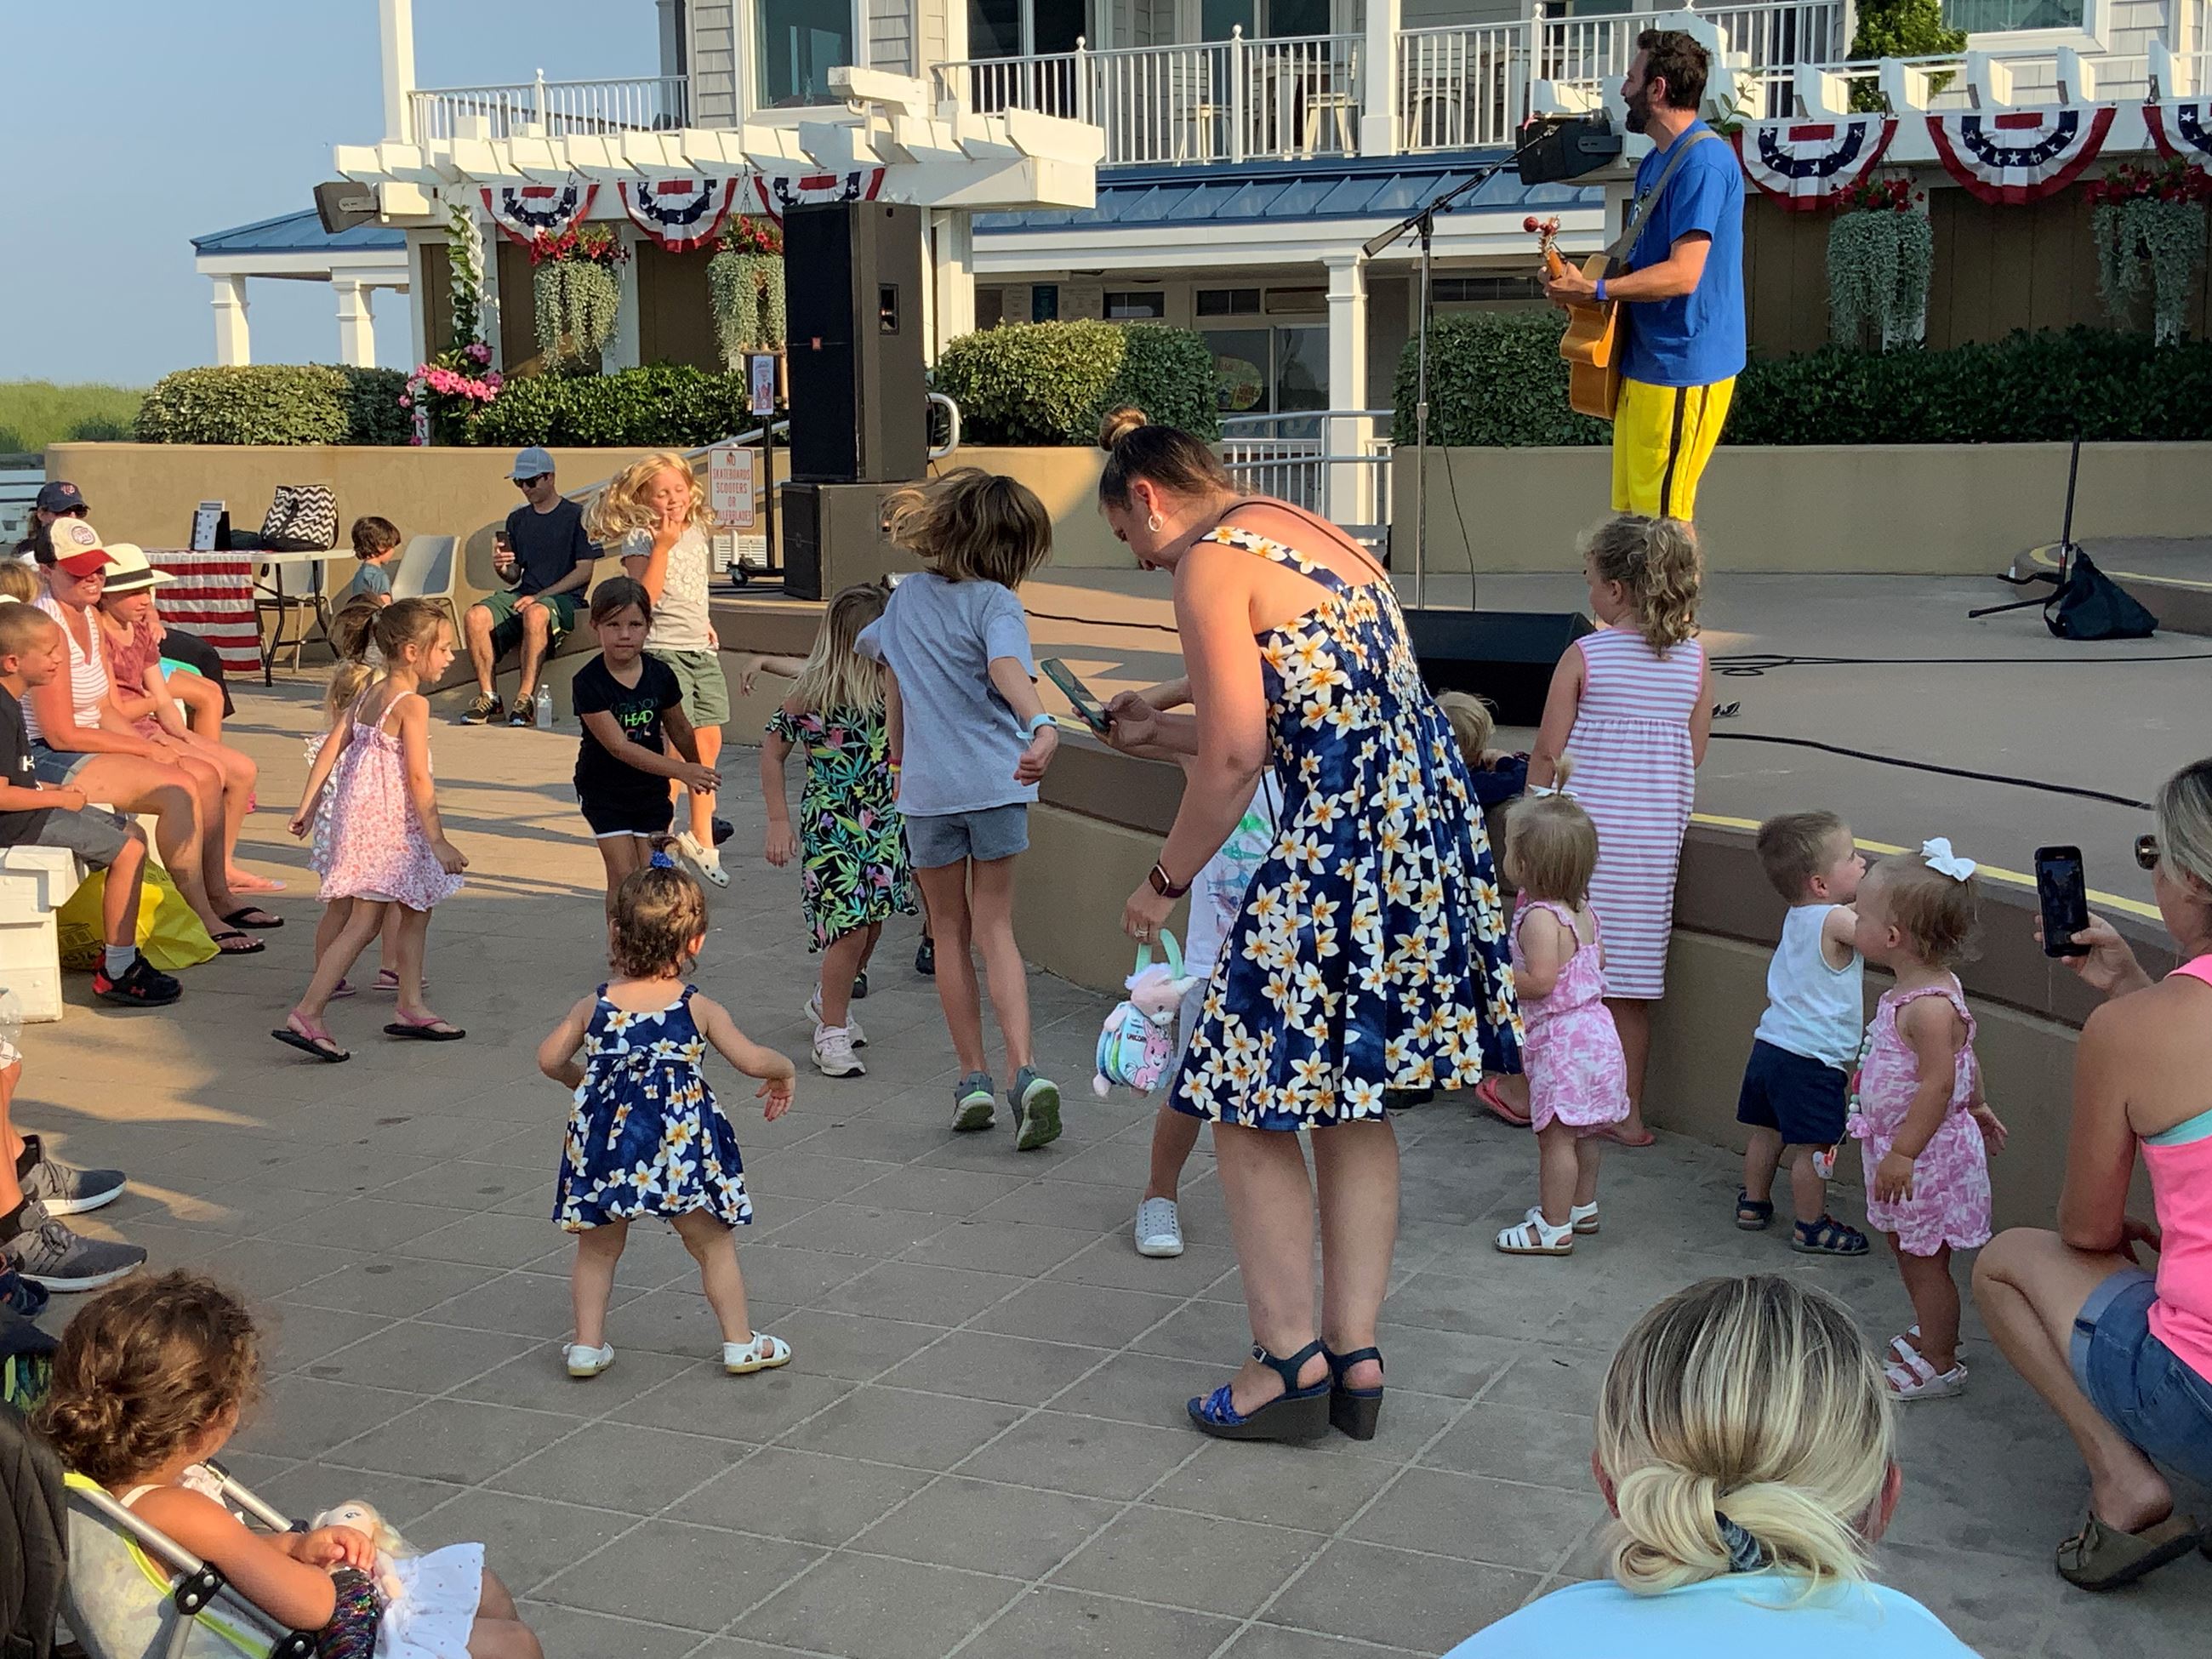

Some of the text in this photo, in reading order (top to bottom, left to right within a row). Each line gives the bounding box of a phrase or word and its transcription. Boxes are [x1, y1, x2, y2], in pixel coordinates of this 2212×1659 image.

[727, 454, 736, 466] NO
[713, 469, 750, 480] SKATEBOARDS
[716, 482, 748, 493] SCOOTERS
[727, 496, 736, 507] OR
[718, 510, 752, 522] LLERBLADES
[624, 710, 654, 727] HEAD
